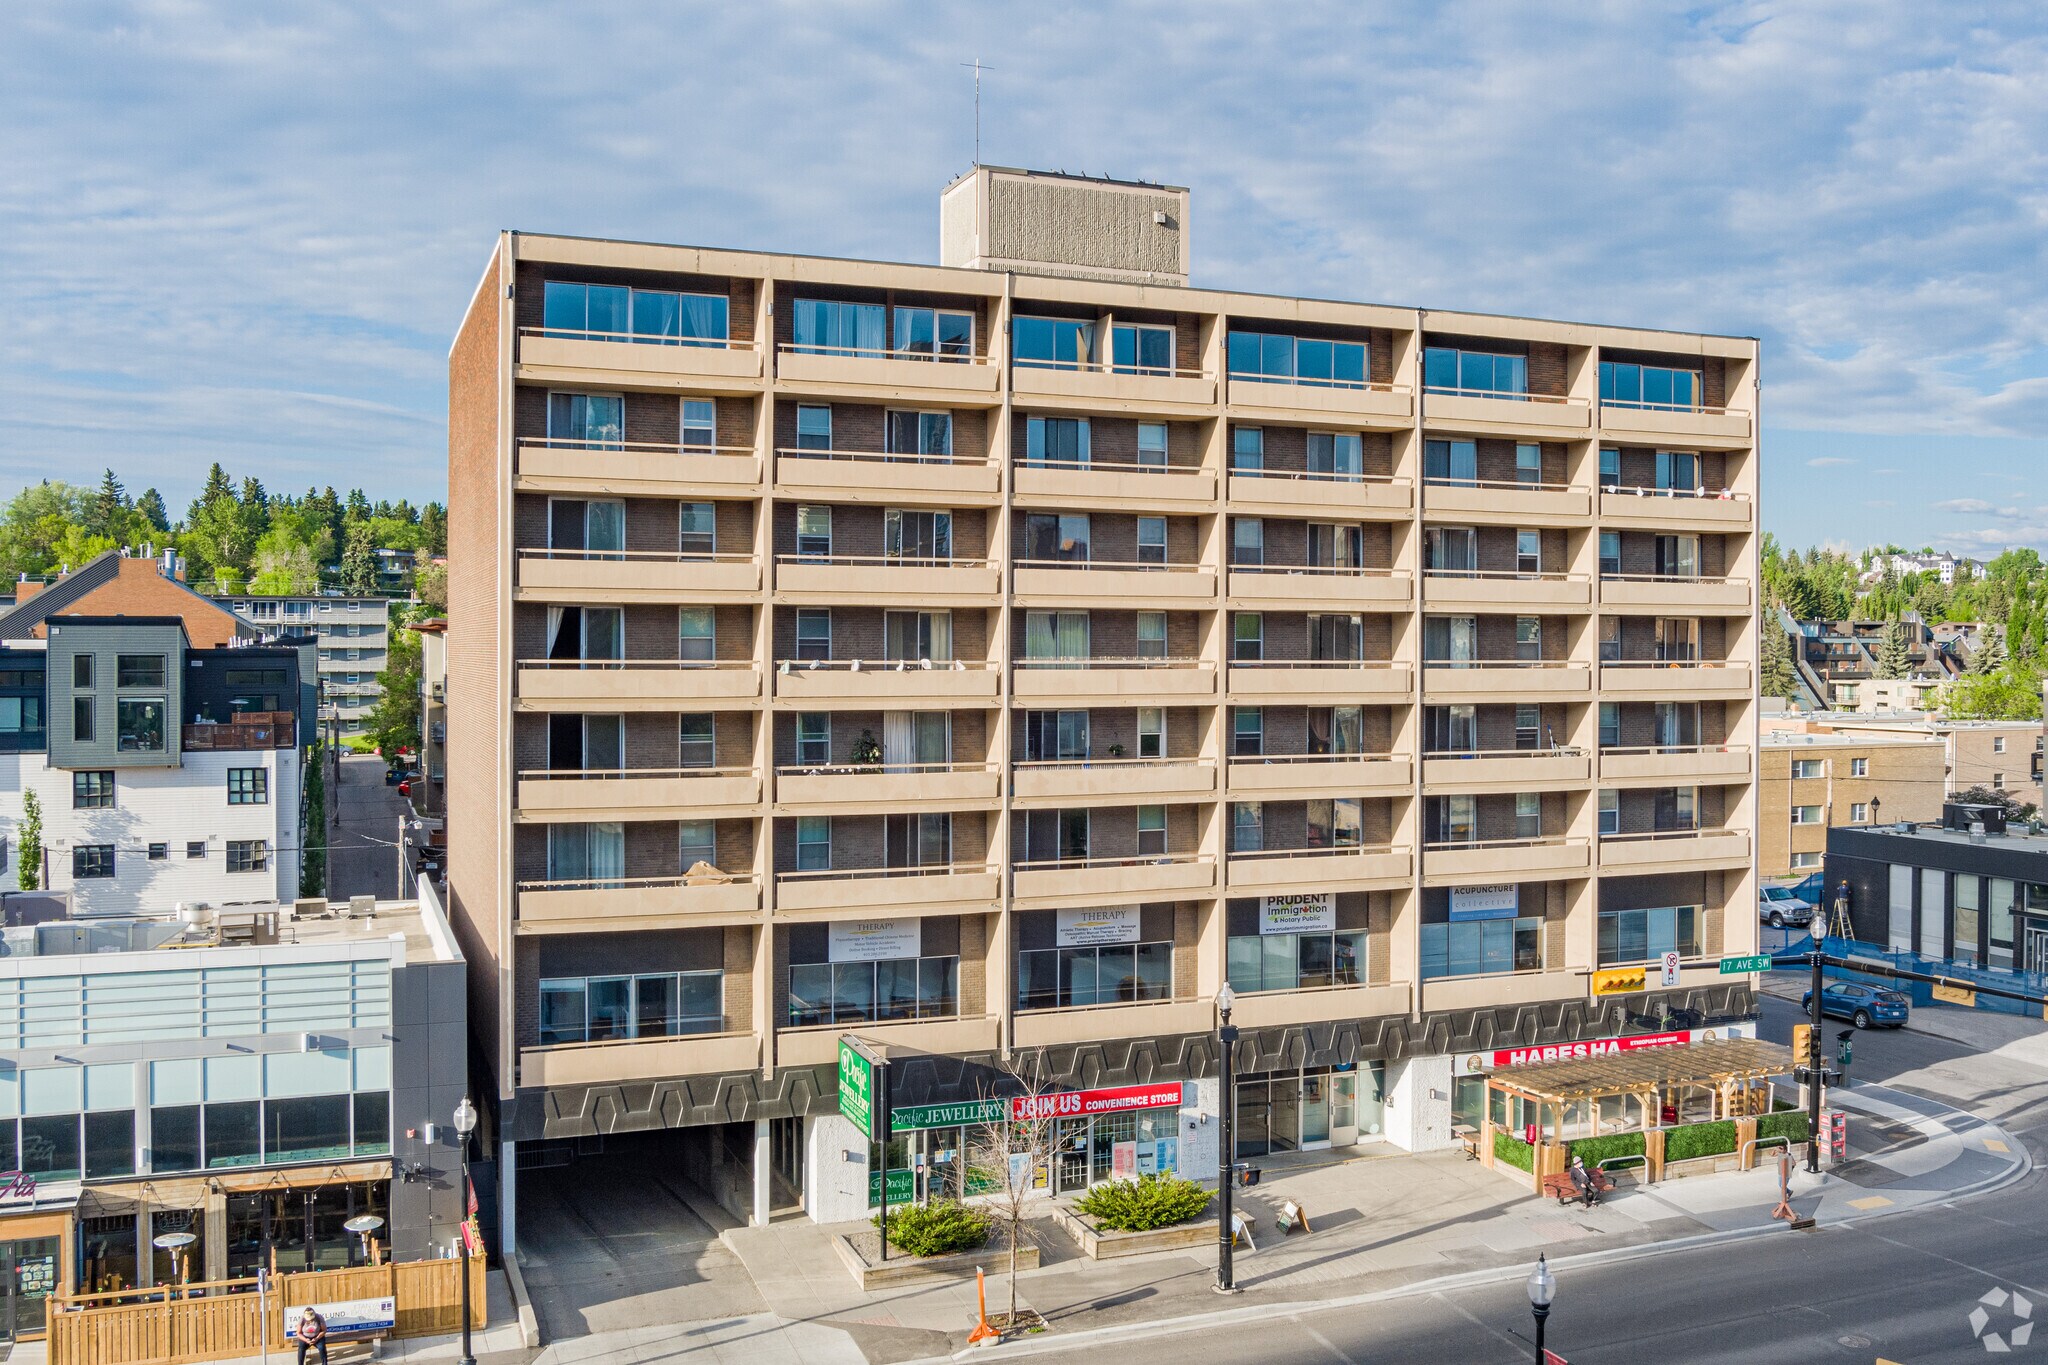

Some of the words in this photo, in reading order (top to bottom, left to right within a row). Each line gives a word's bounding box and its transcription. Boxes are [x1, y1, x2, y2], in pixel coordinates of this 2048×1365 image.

[1454, 885, 1514, 895] ACUPUNCTURE
[1267, 893, 1329, 906] PRUDENT
[1455, 899, 1513, 908] collective
[1081, 911, 1127, 921] THERAPY
[857, 922, 895, 931] THERAPY
[1722, 961, 1733, 971] 17
[1736, 959, 1753, 970] AVE
[1757, 958, 1770, 968] SW
[841, 1048, 867, 1096] Pacific
[839, 1078, 870, 1114] JEWELLERY
[1016, 1097, 1055, 1117] JOIN
[1059, 1094, 1082, 1113] US
[1085, 1096, 1148, 1111] CONVENIENCE
[1150, 1092, 1179, 1104] STORE
[925, 1102, 1003, 1124] JEWELLERY
